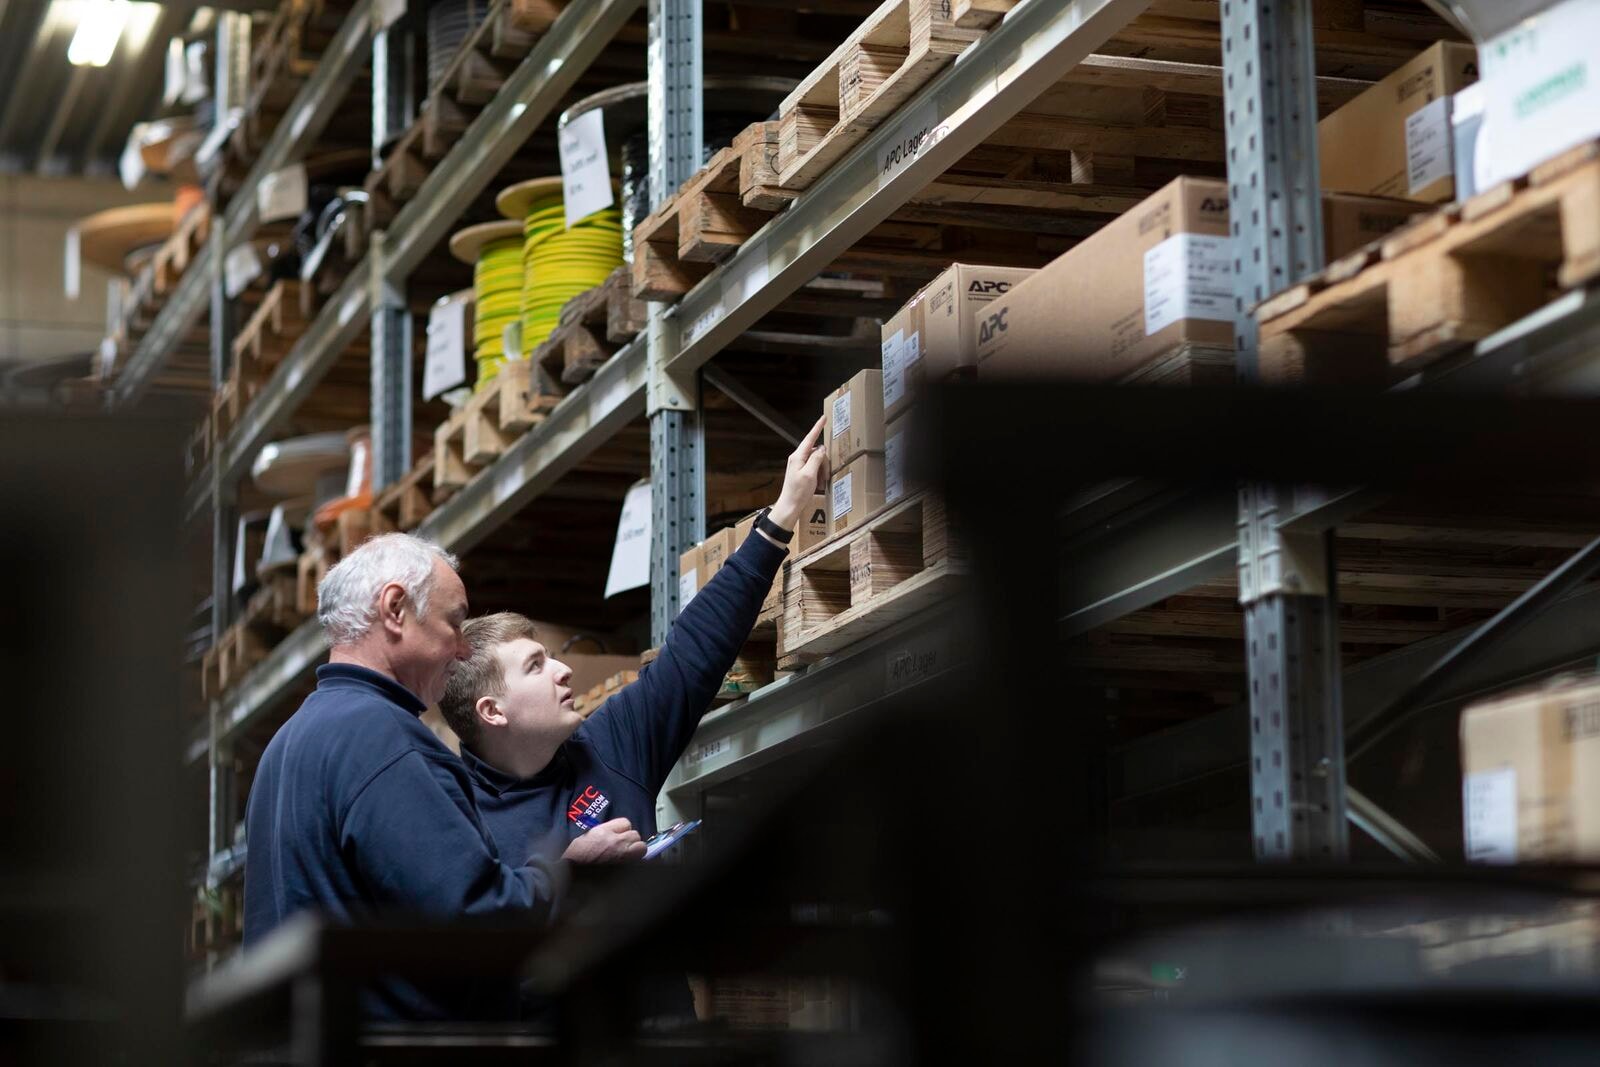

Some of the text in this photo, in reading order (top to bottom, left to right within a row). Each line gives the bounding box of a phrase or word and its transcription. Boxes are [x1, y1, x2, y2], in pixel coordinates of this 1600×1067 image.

[883, 127, 928, 175] APC Lager
[968, 280, 1009, 294] APC
[979, 306, 1009, 347] APC
[893, 650, 937, 680] APC Lager
[568, 785, 599, 822] NTC
